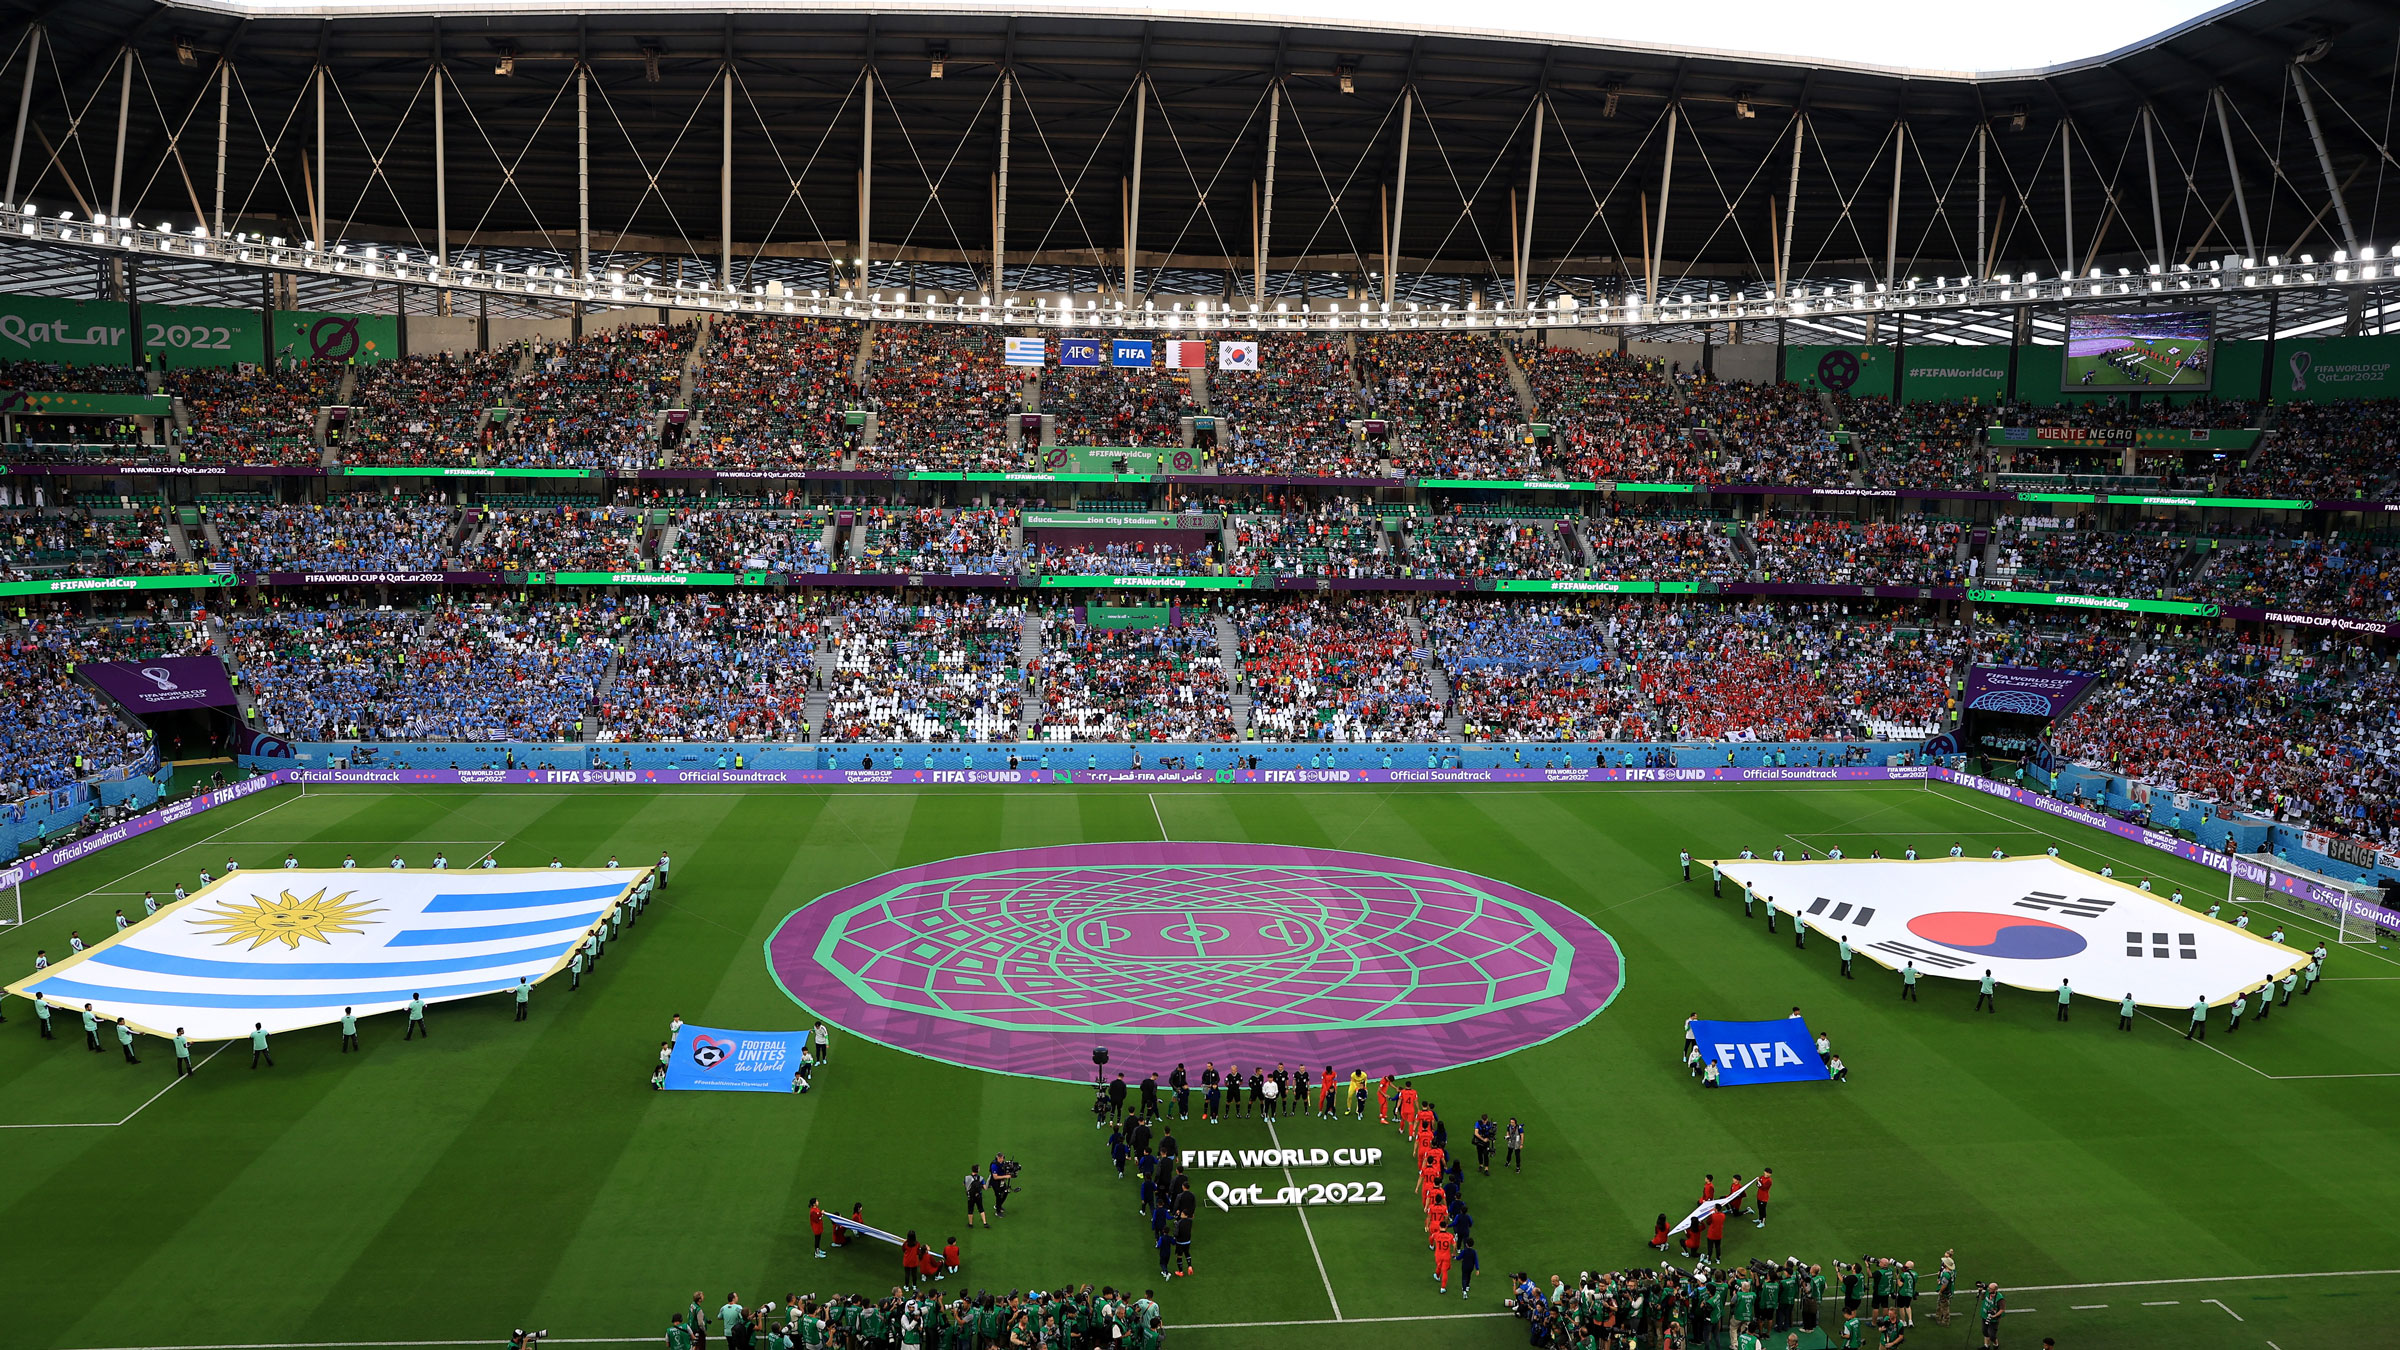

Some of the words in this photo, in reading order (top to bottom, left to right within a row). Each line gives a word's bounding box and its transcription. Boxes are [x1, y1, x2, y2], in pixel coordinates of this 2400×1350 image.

[0, 315, 125, 349] Qatar
[1065, 346, 1094, 359] AFC
[1118, 348, 1146, 359] FIFA
[1909, 368, 2004, 380] #FIFAWorldCup
[2318, 373, 2384, 384] Qatar2022
[2037, 428, 2085, 439] PUENTE
[2090, 429, 2132, 439] NEGRO
[1089, 450, 1151, 460] #FIFAWorldCup
[2143, 497, 2196, 506] #FIFAWorldCup
[1106, 516, 1122, 526] City
[1124, 516, 1157, 525] Stadium
[305, 574, 325, 582] FIFA
[326, 573, 359, 582] WORLD
[360, 573, 378, 582] CUP
[386, 573, 444, 582] Qatar2022
[612, 574, 687, 584] #FIFAWorldCup
[1113, 577, 1186, 587] #FIFAWorldCup
[51, 579, 137, 590] #FIFAWorldCup
[1551, 582, 1619, 592] #FIFAWorldCup
[2055, 595, 2129, 610] #FIFAWorldCup
[2265, 612, 2282, 621] FIFA
[2283, 614, 2313, 624] WORLD
[2314, 618, 2330, 626] CUP
[2338, 618, 2386, 633] Qatar2022
[290, 771, 331, 780] Oficial
[335, 771, 400, 780] Soundtrack
[548, 771, 579, 782] FIFA
[679, 771, 720, 782] Official
[722, 771, 787, 782] Soundtrack
[933, 771, 965, 782] FIFA
[1265, 771, 1295, 782] FIFA
[1390, 770, 1428, 780] Official
[1431, 770, 1491, 781] Soundtrack
[1626, 769, 1655, 780] FIFA
[1743, 769, 1779, 779] Official
[1781, 769, 1837, 779] Soundtrack
[1954, 772, 1976, 789] FIFA
[213, 787, 234, 805] FIFA
[2035, 797, 2063, 816] Official
[2063, 805, 2107, 828] Soundtrack
[53, 846, 82, 864] Official
[82, 827, 127, 853] Soundtrack
[2331, 840, 2375, 868] SPENGE
[2202, 850, 2228, 872] FIFA
[742, 1040, 786, 1050] FOOTBALL
[738, 1050, 785, 1061] UNITES
[1714, 1042, 1804, 1069] FIFA
[734, 1062, 752, 1072] the
[753, 1061, 784, 1072] World
[1422, 1139, 1428, 1147] 6
[1181, 1150, 1236, 1168] FIFA
[1239, 1149, 1330, 1168] WORLD
[1333, 1148, 1382, 1166] CUP
[1206, 1180, 1386, 1212] Qatar2022
[1437, 1241, 1450, 1250] 19
